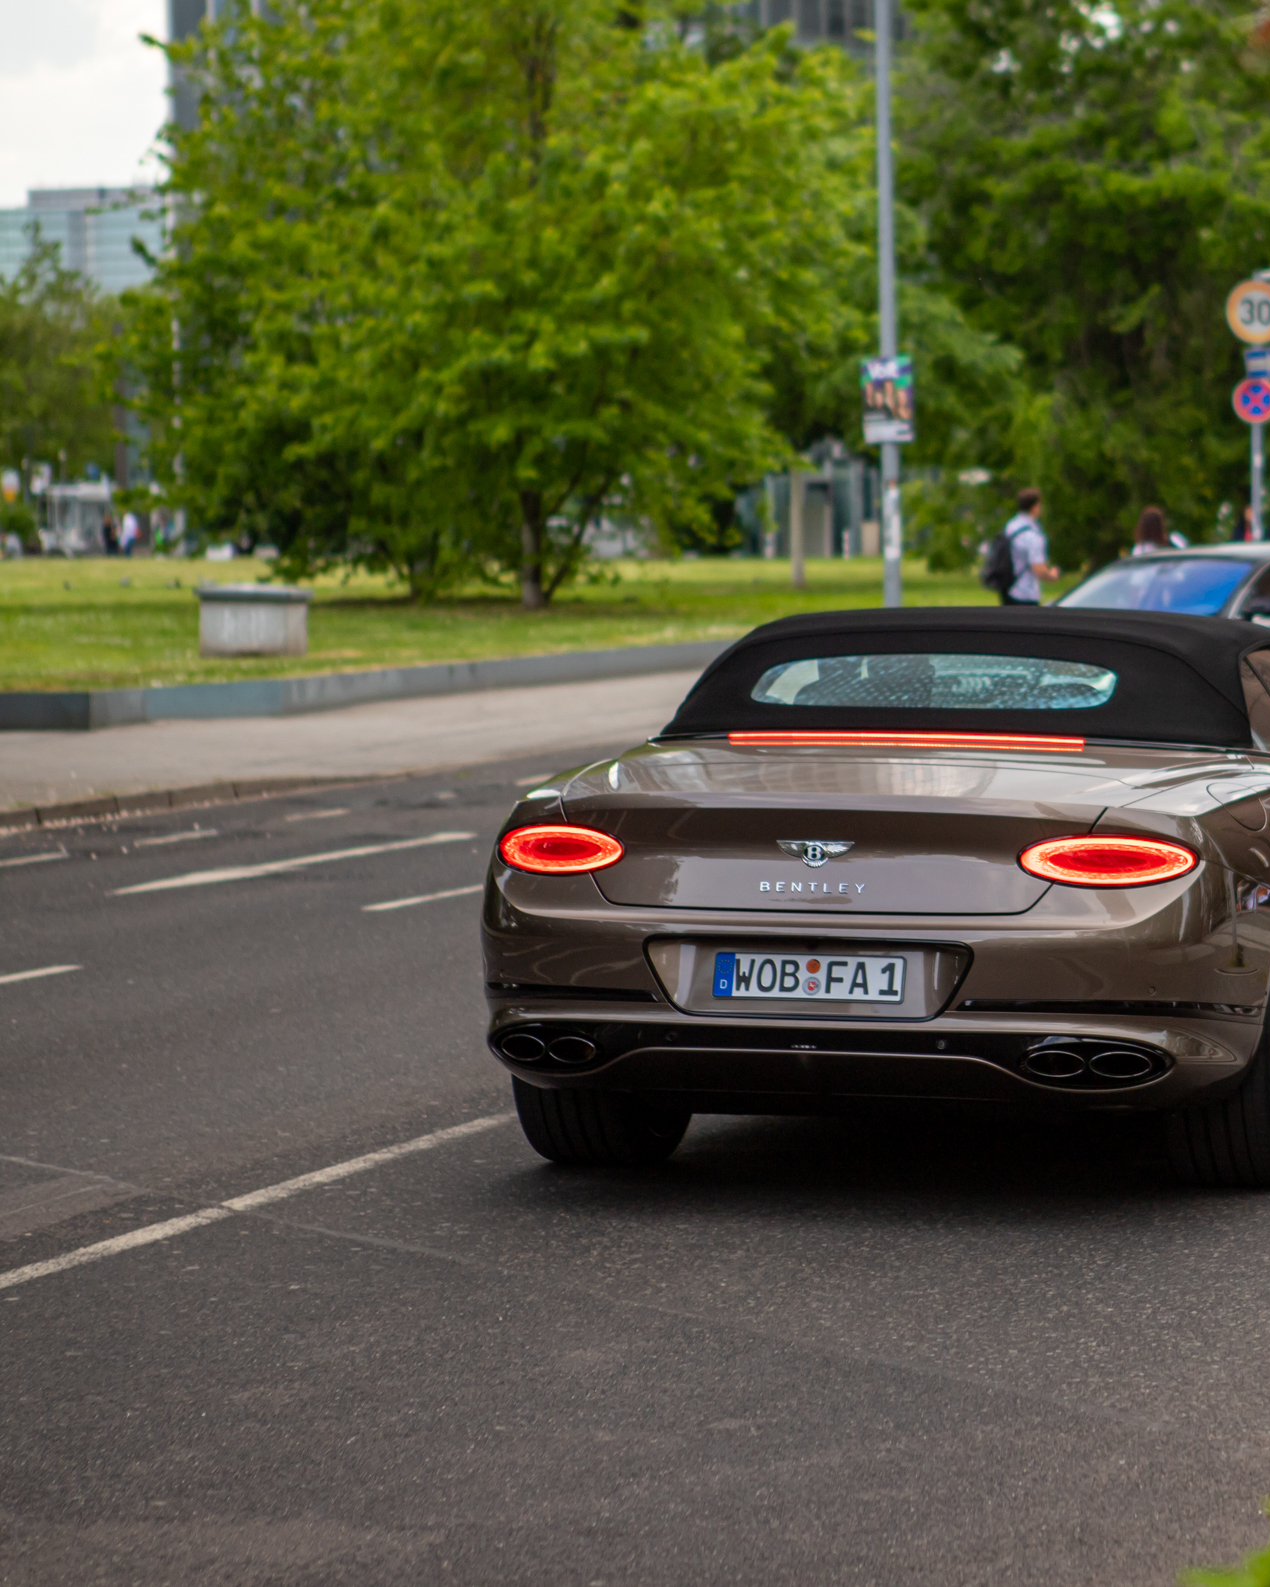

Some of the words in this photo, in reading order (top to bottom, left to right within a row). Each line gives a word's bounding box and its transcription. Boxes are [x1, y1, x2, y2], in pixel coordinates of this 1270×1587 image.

[806, 846, 822, 860] B
[759, 881, 865, 894] BENTLEY
[735, 958, 800, 992] WOB
[719, 979, 728, 990] D
